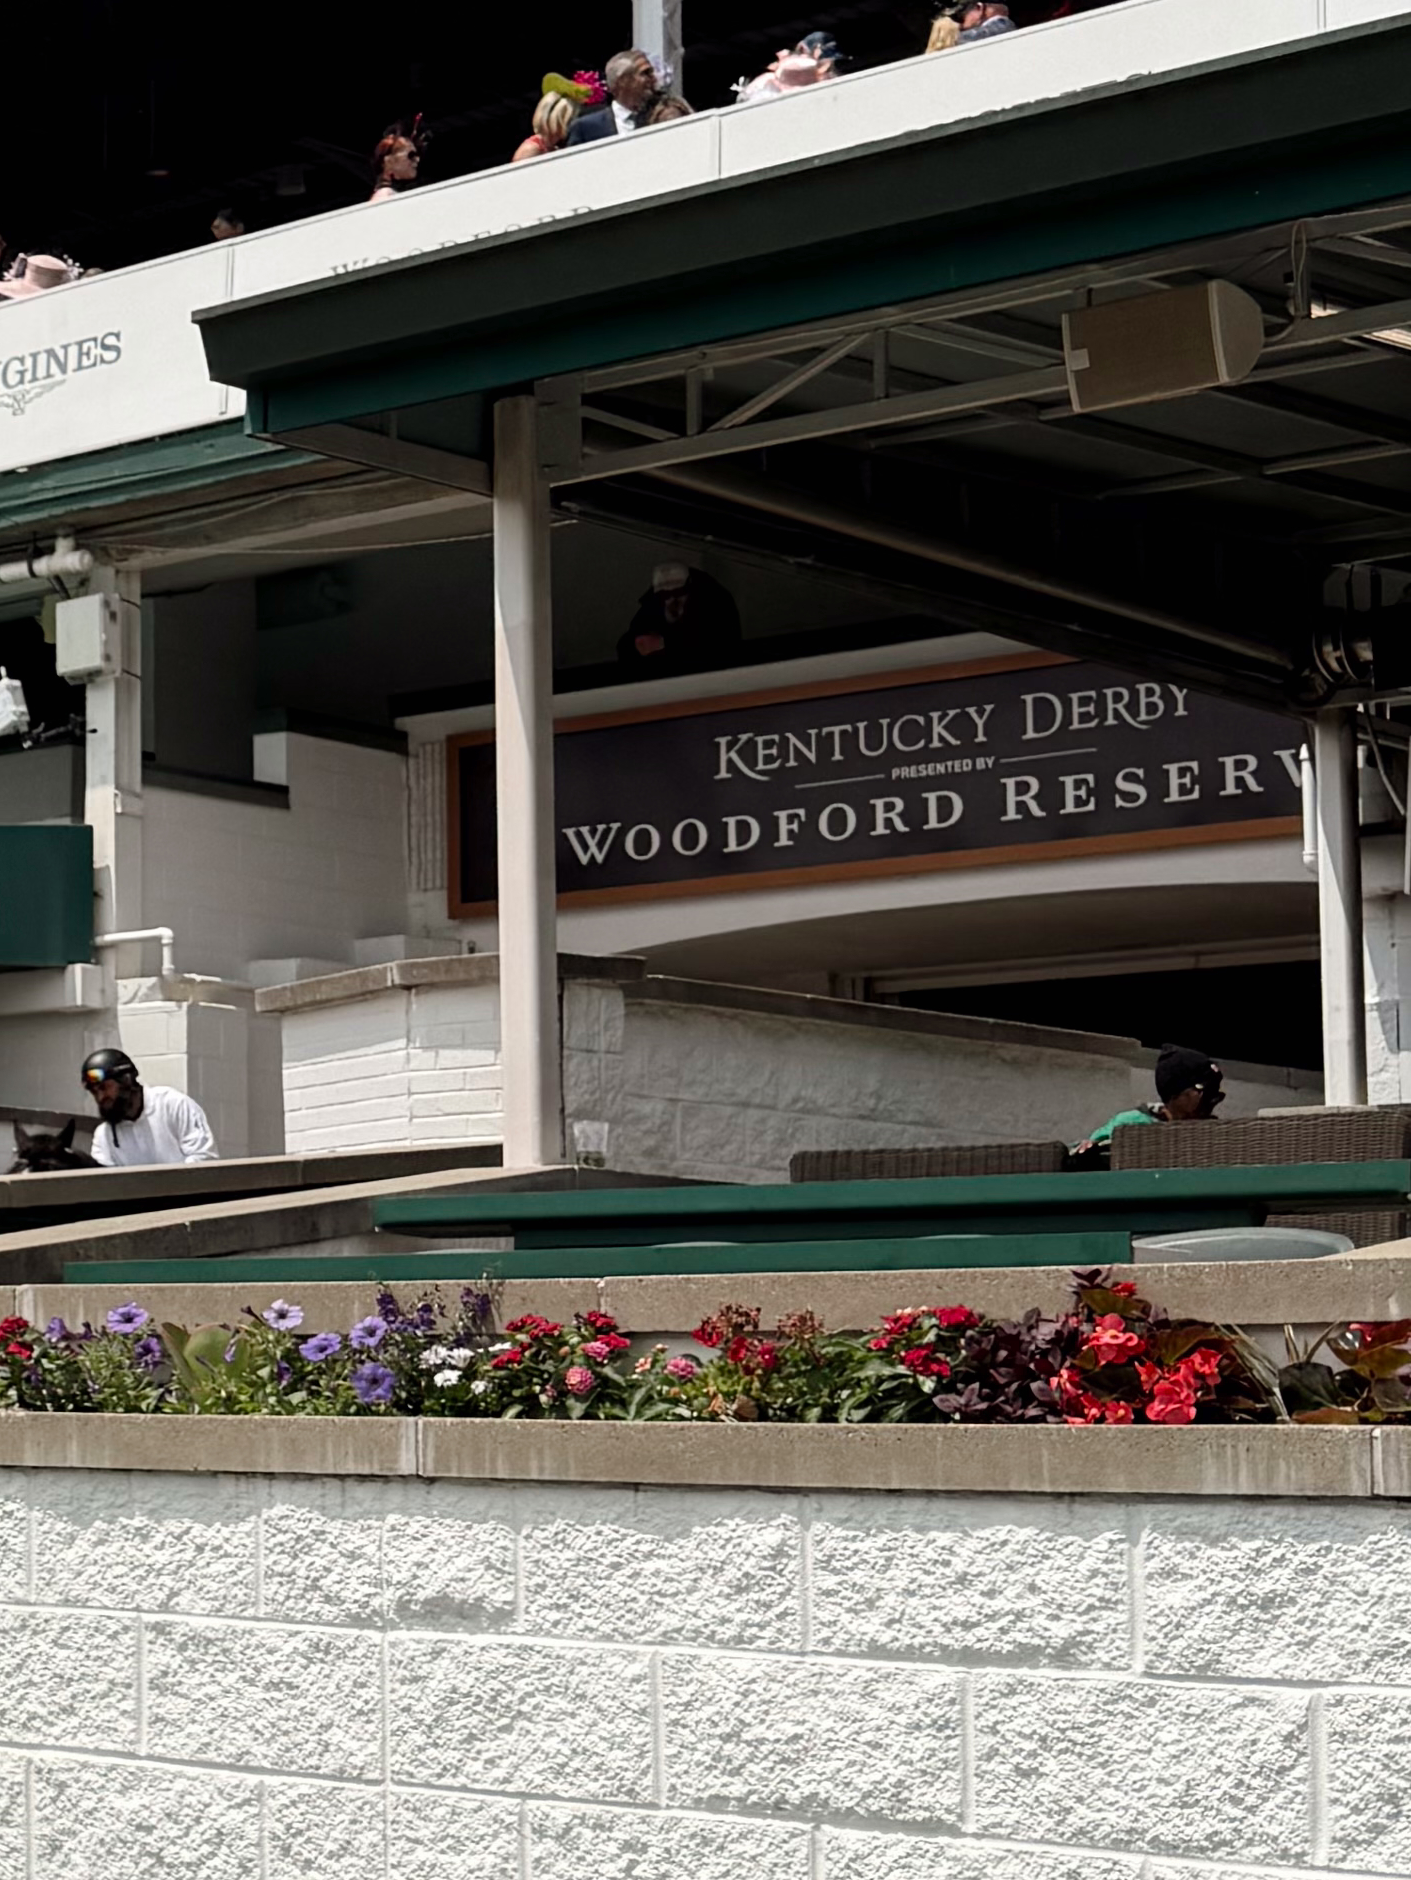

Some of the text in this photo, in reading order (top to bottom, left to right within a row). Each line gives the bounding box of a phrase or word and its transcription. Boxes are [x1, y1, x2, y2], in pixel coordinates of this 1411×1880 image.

[713, 681, 1189, 782] KENTUCKY DERBY
[890, 755, 996, 781] PRESENTED BY
[561, 748, 1302, 867] WOODFORD RESERV
